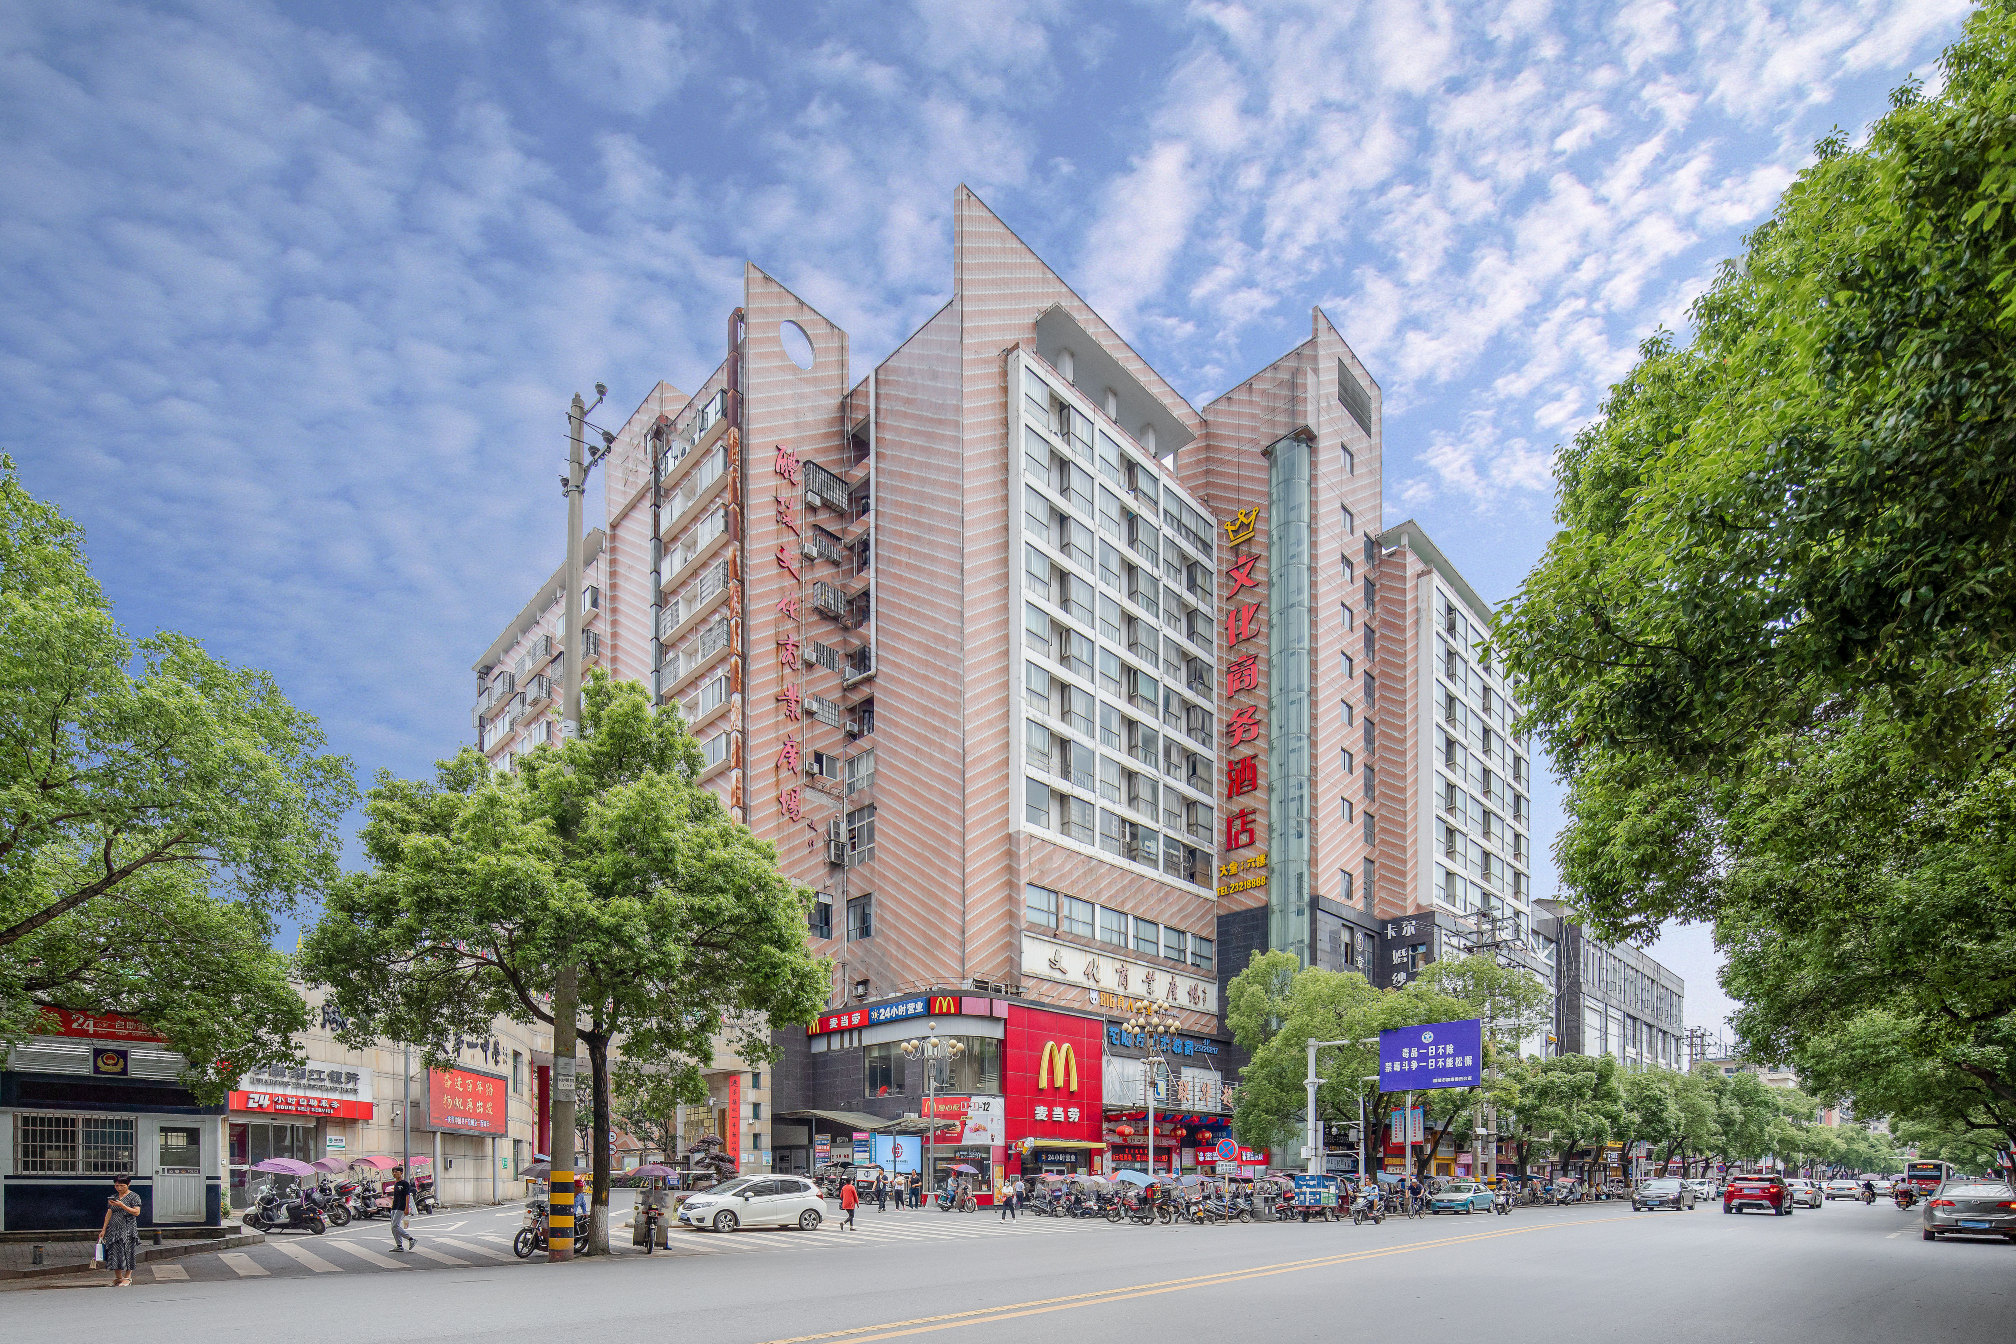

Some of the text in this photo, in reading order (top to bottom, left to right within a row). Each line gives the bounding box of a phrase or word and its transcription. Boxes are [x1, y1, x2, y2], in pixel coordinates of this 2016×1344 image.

[1224, 554, 1262, 851] 文化商务酒店
[1229, 875, 1268, 895] 23218888
[879, 1001, 924, 1020] 24小时营业
[115, 1020, 150, 1031] 自助银
[829, 1012, 861, 1029] 麦当劳
[1402, 1043, 1454, 1059] 毒品一日不除
[1385, 1055, 1473, 1073] 禁毒斗争一日不能松懈
[443, 1073, 494, 1097] 奋进百年路
[1177, 1079, 1237, 1109] 联华超
[1034, 1105, 1080, 1122] 麦当劳
